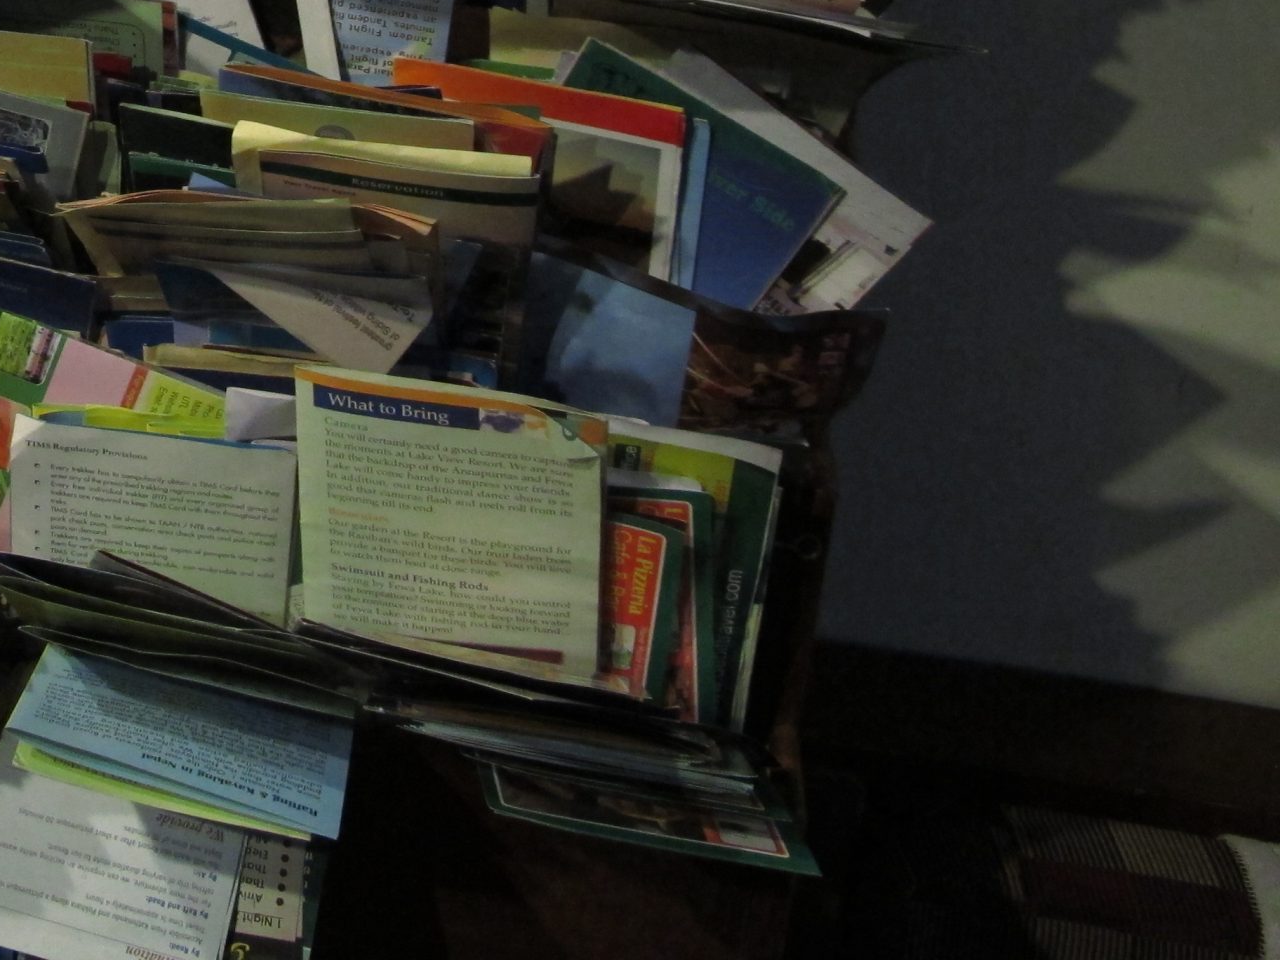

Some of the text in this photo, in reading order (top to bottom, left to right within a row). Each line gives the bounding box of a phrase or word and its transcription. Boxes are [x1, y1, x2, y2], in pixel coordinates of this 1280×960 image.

[349, 24, 382, 37] Flight
[389, 31, 433, 46] Tandem
[351, 177, 444, 199] Reservation
[328, 392, 450, 426] What to Bring
[324, 416, 368, 432] Camera
[25, 440, 148, 461] TIMS Regulatory Provisions
[325, 428, 344, 437] You
[346, 430, 366, 440] will
[368, 433, 411, 450] certainly
[415, 441, 440, 452] need
[450, 446, 477, 457] good
[408, 450, 434, 461] Lake
[438, 453, 462, 464] View
[330, 562, 489, 591] Swimsuit and Fishing Rods
[628, 535, 656, 615] La Pizzeria
[141, 751, 318, 817] Rafting & Kayaking in Nepal
[156, 812, 224, 841] We provide
[247, 912, 276, 928] Night
